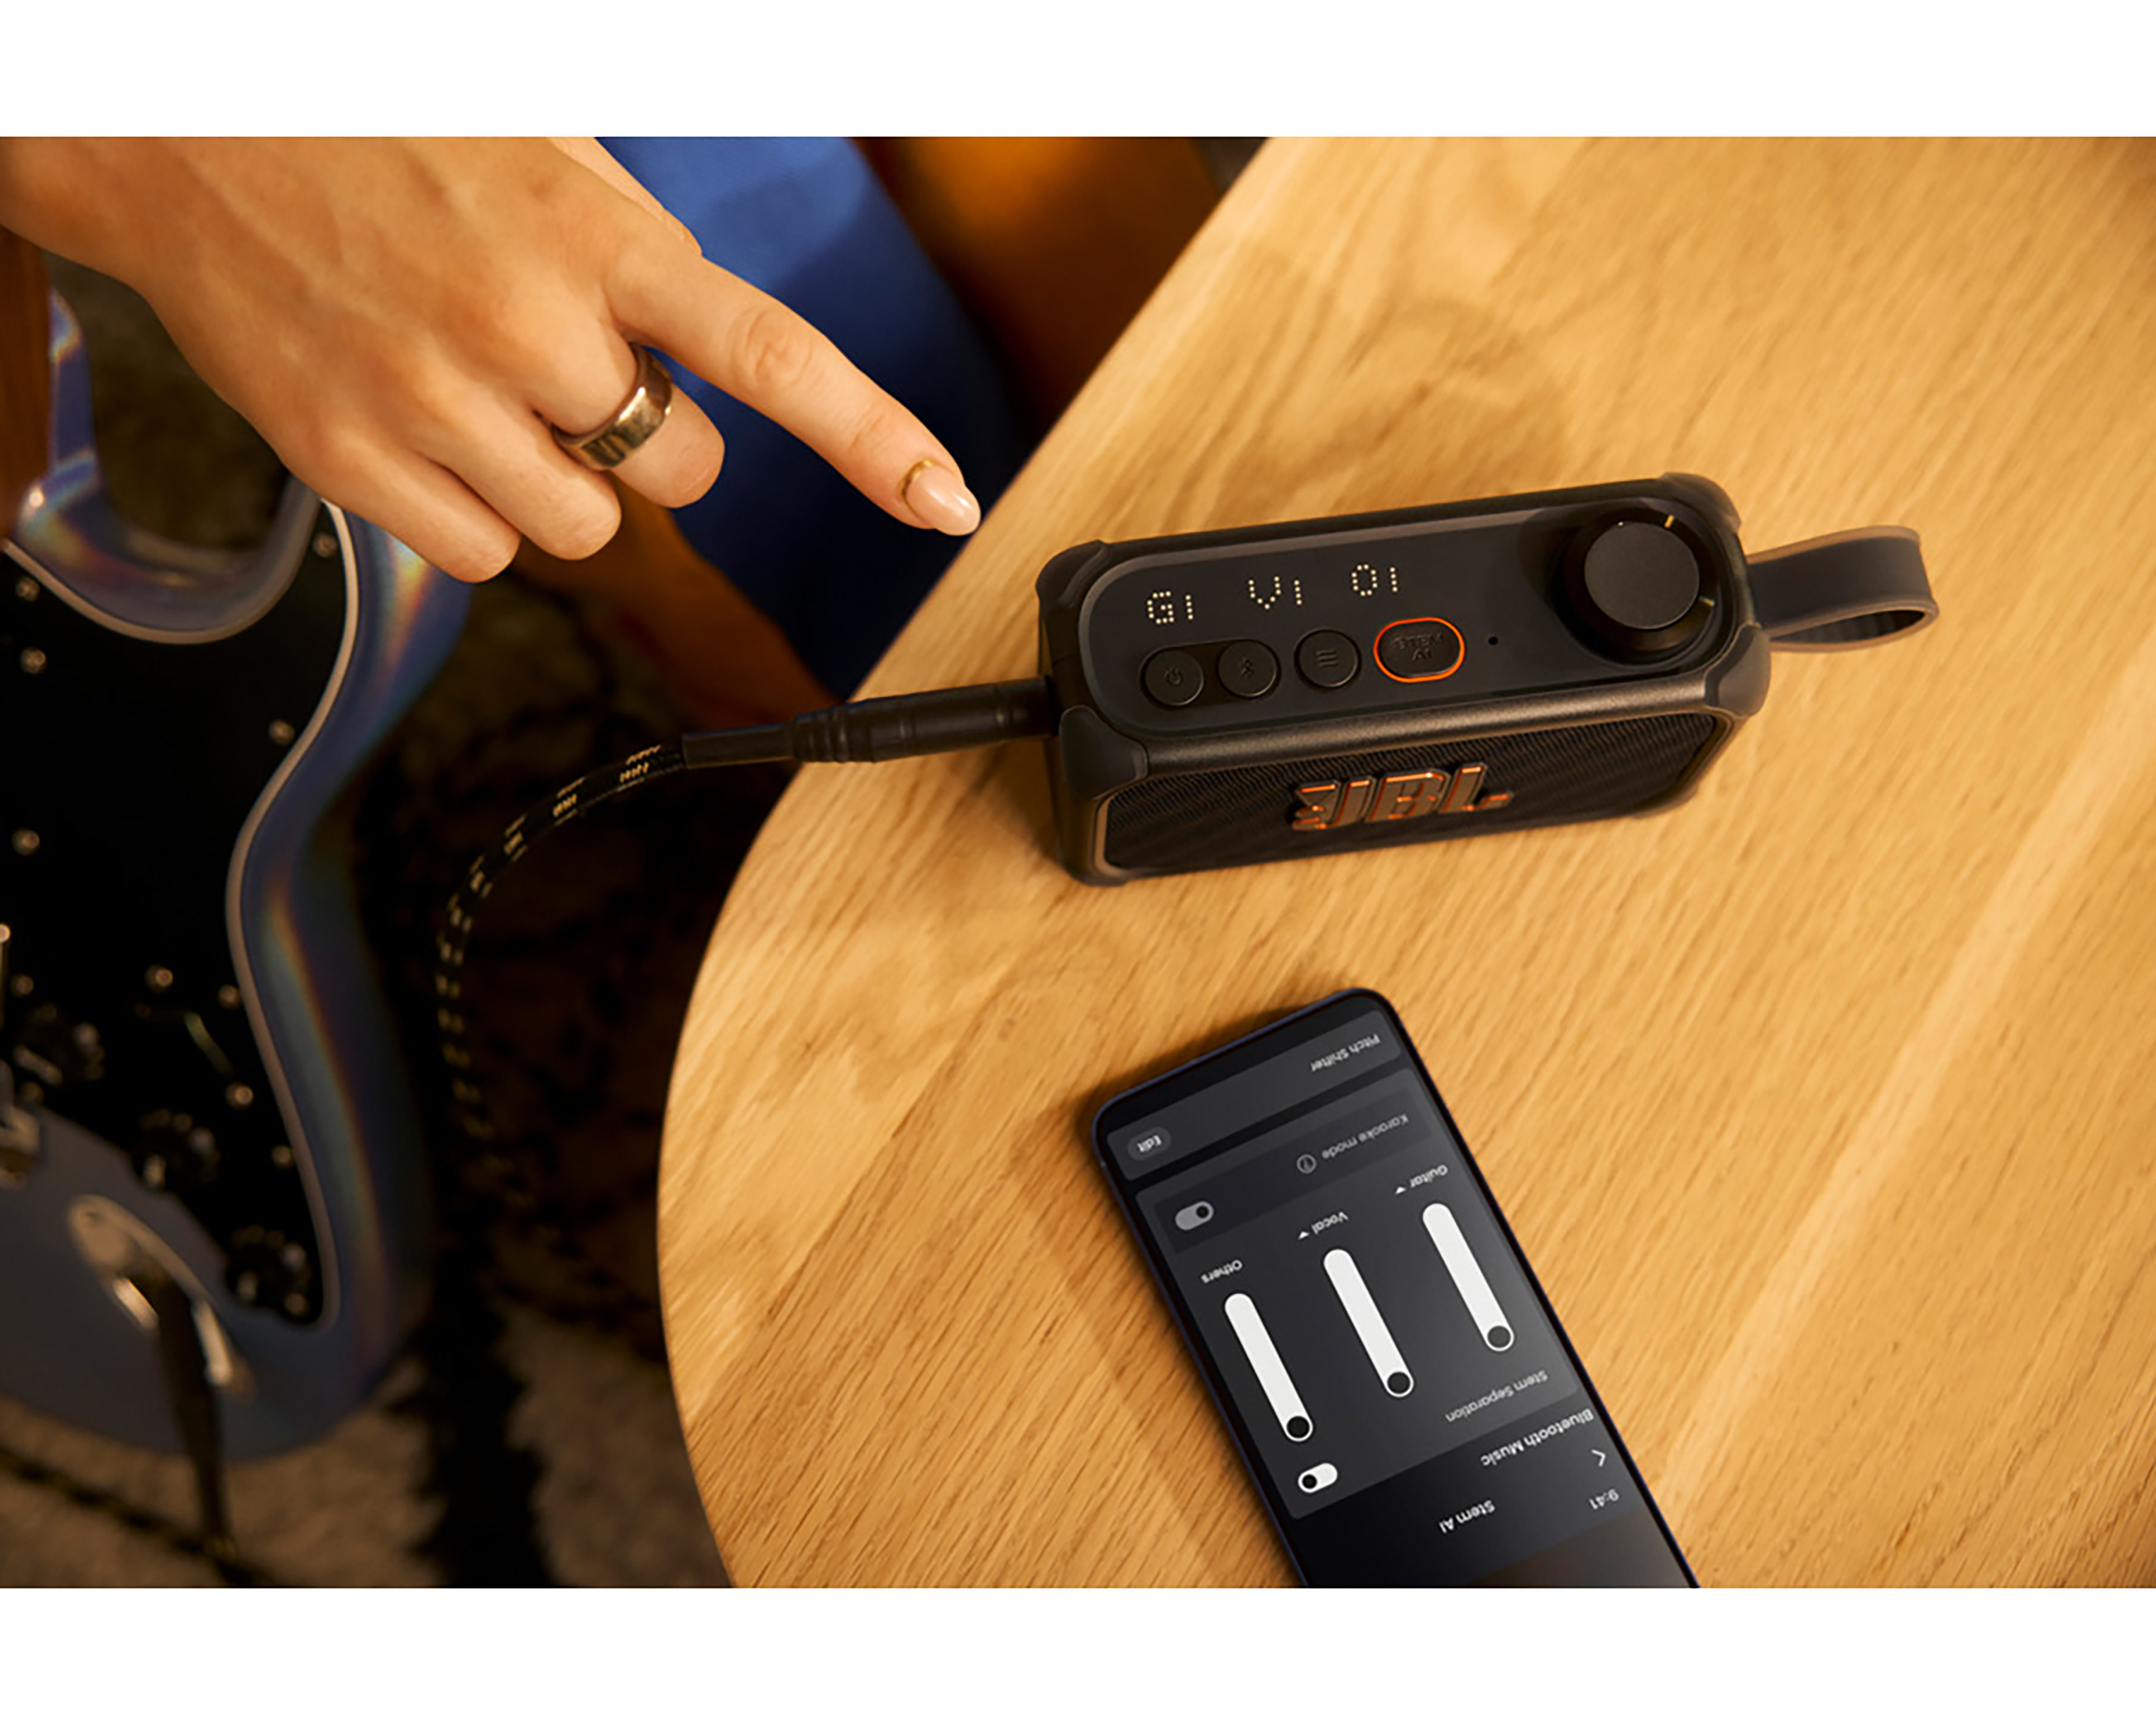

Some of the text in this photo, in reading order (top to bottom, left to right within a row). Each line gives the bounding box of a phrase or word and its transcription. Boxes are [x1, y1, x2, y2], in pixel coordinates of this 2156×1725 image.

[1292, 762, 1514, 830] JBL
[1310, 1034, 1381, 1071] Pitch Shifter
[1137, 1135, 1162, 1152] Edit
[1321, 1114, 1409, 1159] Karaoke mode
[1410, 1164, 1448, 1188] Guitar
[1311, 1211, 1349, 1235] Vocal
[1201, 1259, 1243, 1284] Others
[1445, 1370, 1548, 1422] Stem Separation
[1480, 1408, 1594, 1466] Bluetooth Music
[1589, 1489, 1619, 1510] 9:41
[1439, 1500, 1495, 1533] Stem AI
